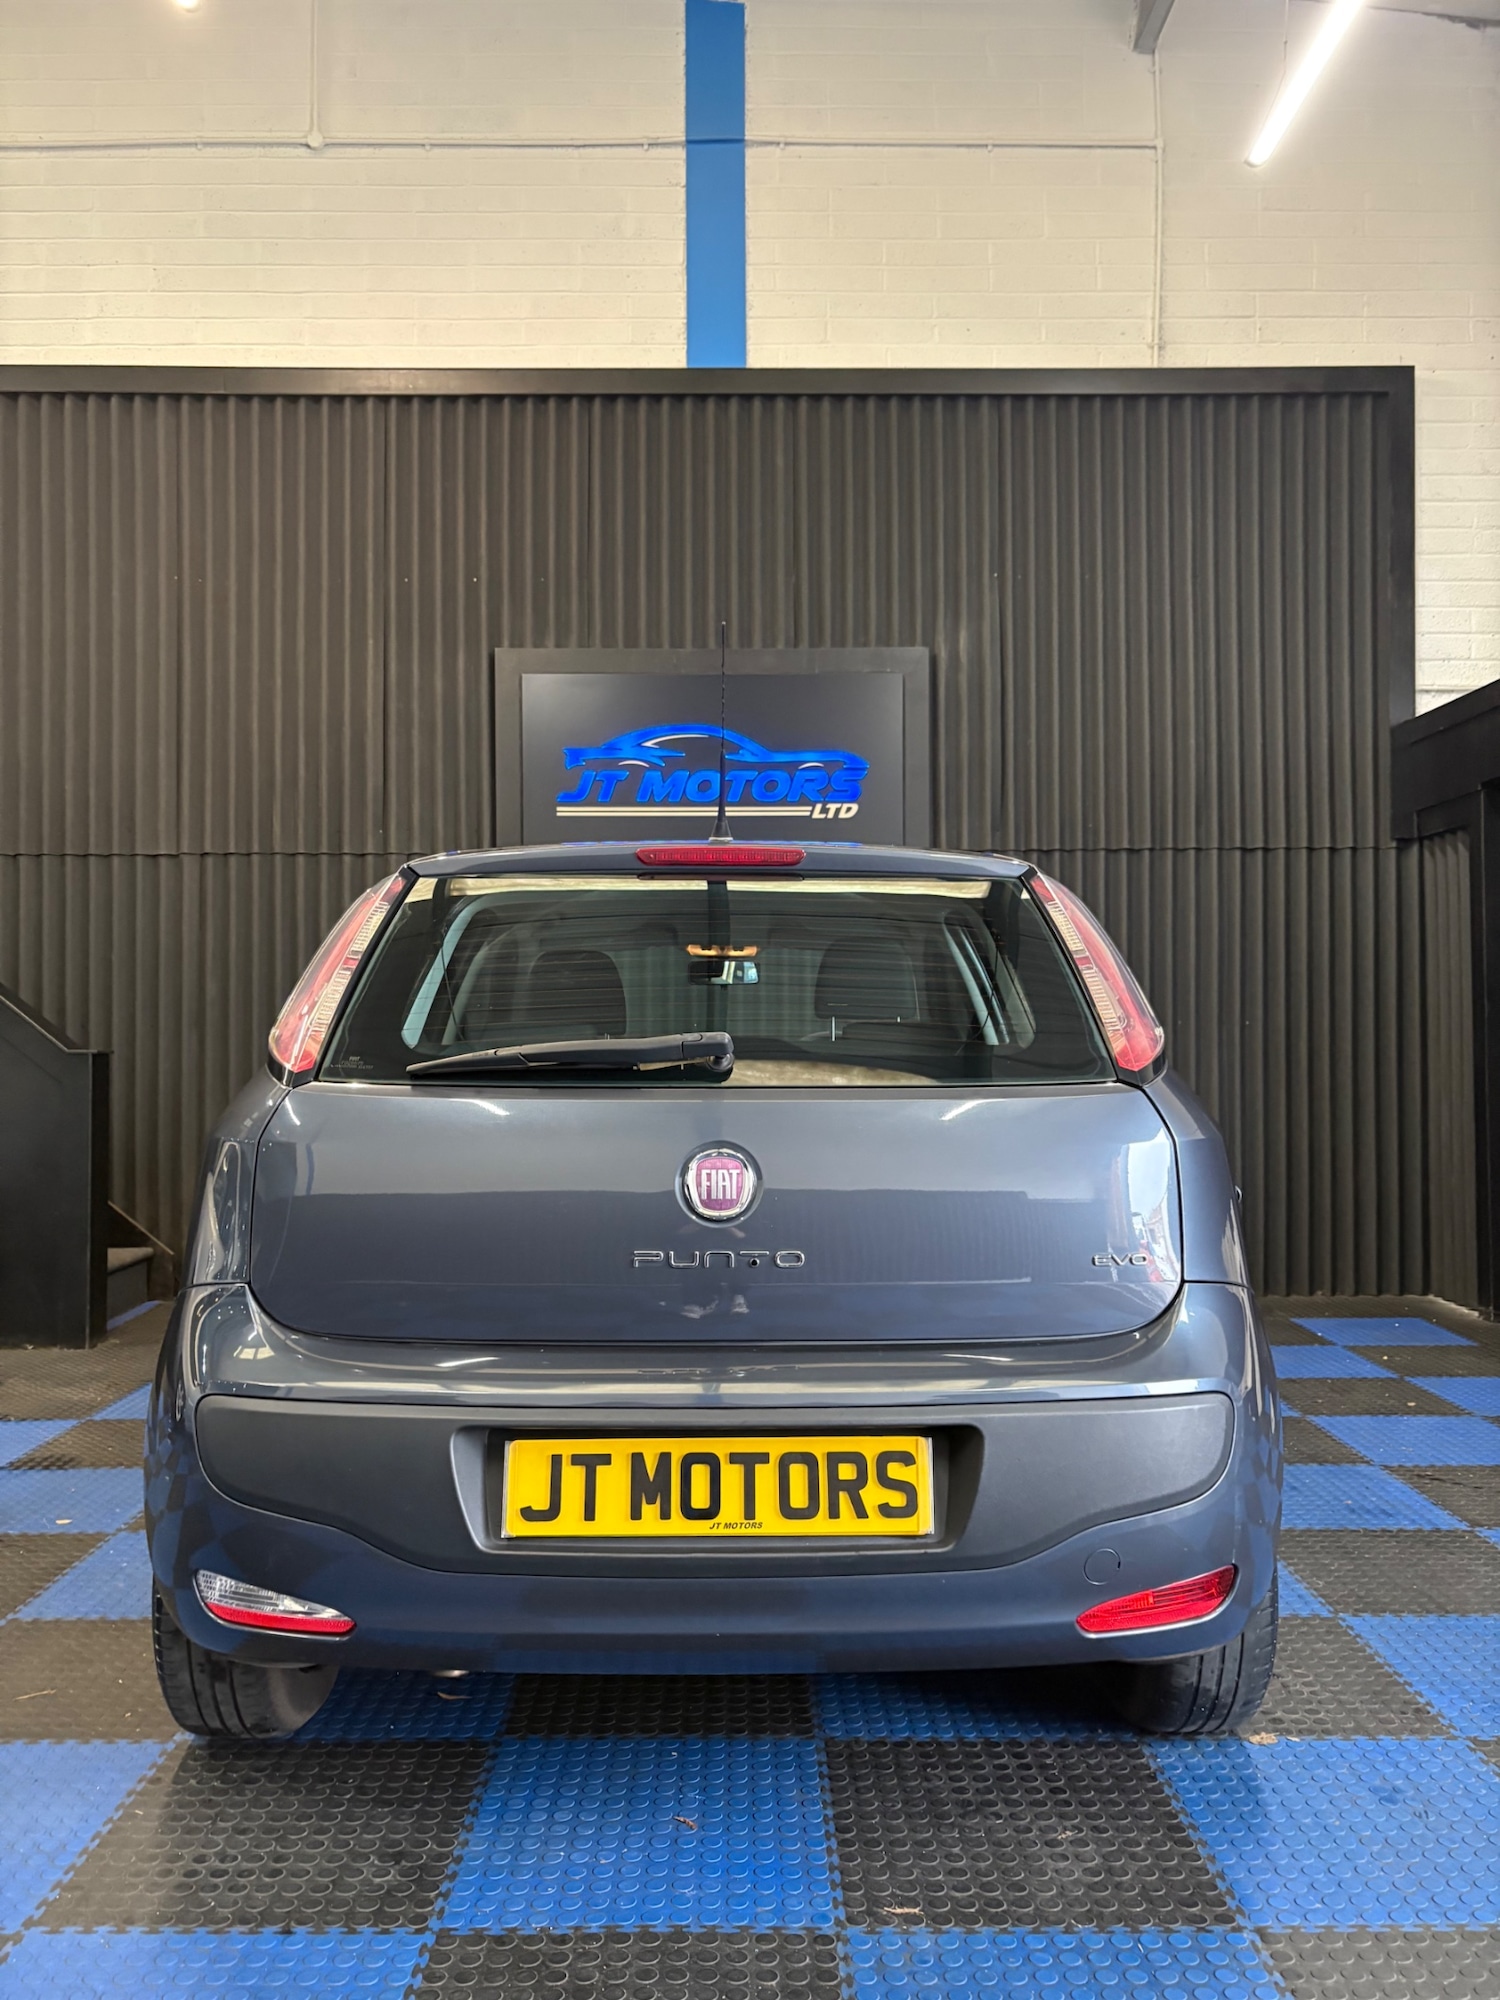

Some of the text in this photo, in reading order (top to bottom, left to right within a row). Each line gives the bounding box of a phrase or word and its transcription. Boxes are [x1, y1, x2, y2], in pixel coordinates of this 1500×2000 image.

[556, 769, 869, 803] JT MOTORS
[811, 803, 859, 819] LTD
[701, 1168, 741, 1200] FIAT
[632, 1250, 805, 1269] PUNTO
[1091, 1253, 1148, 1267] EVO
[519, 1450, 919, 1522] JT MOTORS
[709, 1521, 763, 1530] JT MOTORS
